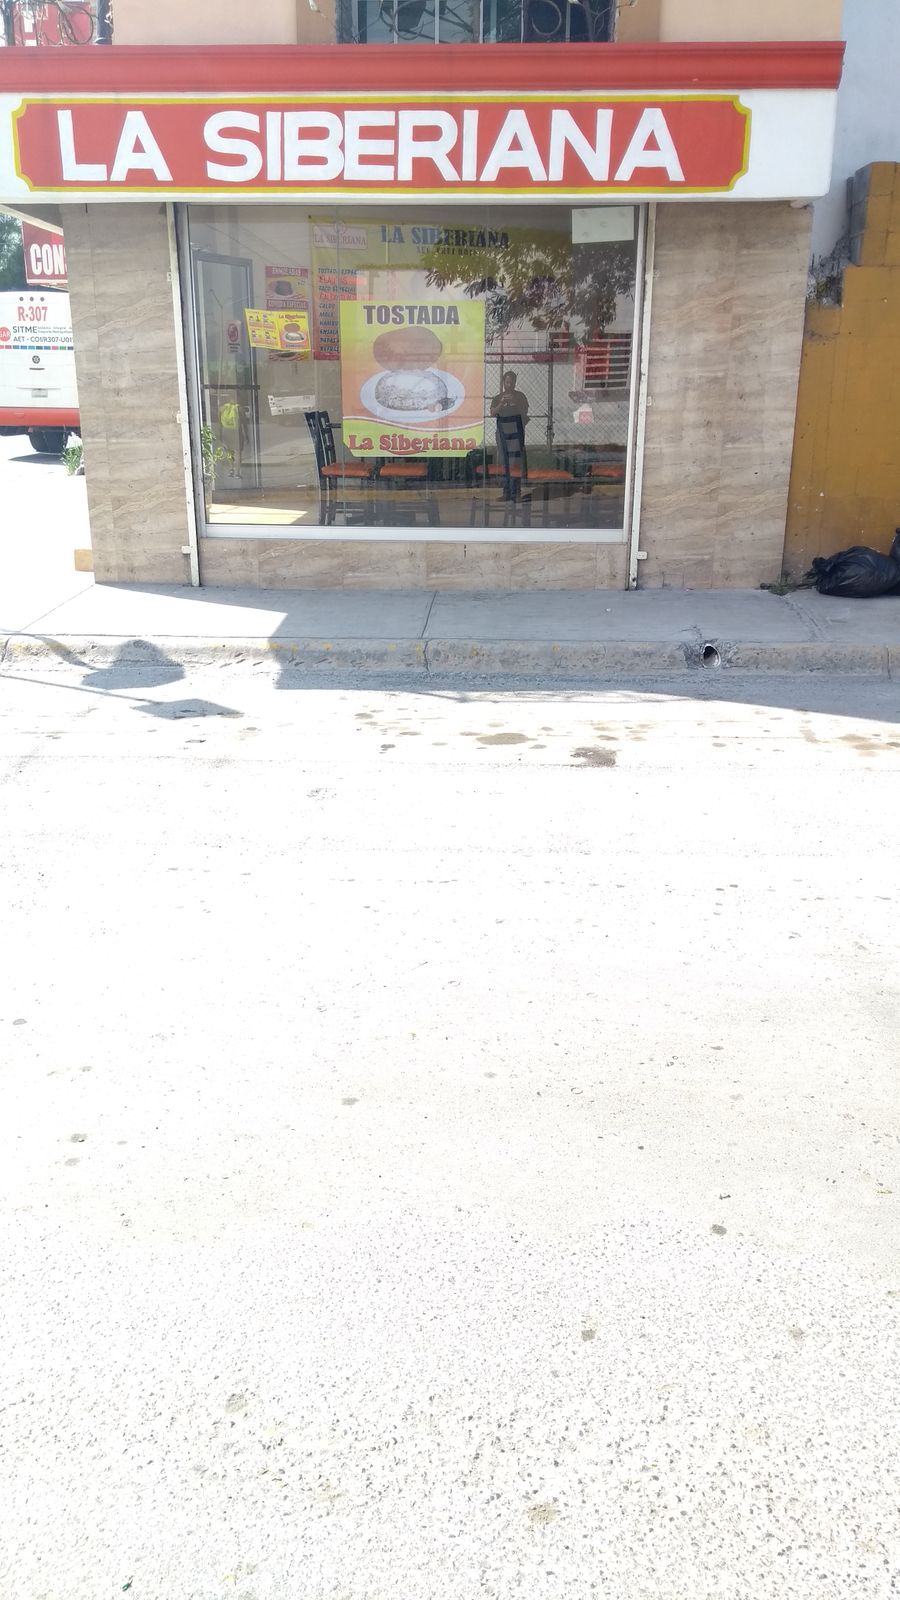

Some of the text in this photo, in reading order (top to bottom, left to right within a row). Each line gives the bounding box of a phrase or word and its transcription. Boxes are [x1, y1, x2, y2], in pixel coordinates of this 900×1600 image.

[58, 107, 685, 184] LA SIBERIANA
[381, 225, 405, 243] LA
[30, 243, 68, 276] CON
[17, 305, 48, 322] R-307
[363, 305, 460, 325] TOSTADA
[12, 325, 38, 334] SITME
[348, 433, 477, 451] La Siberiana
